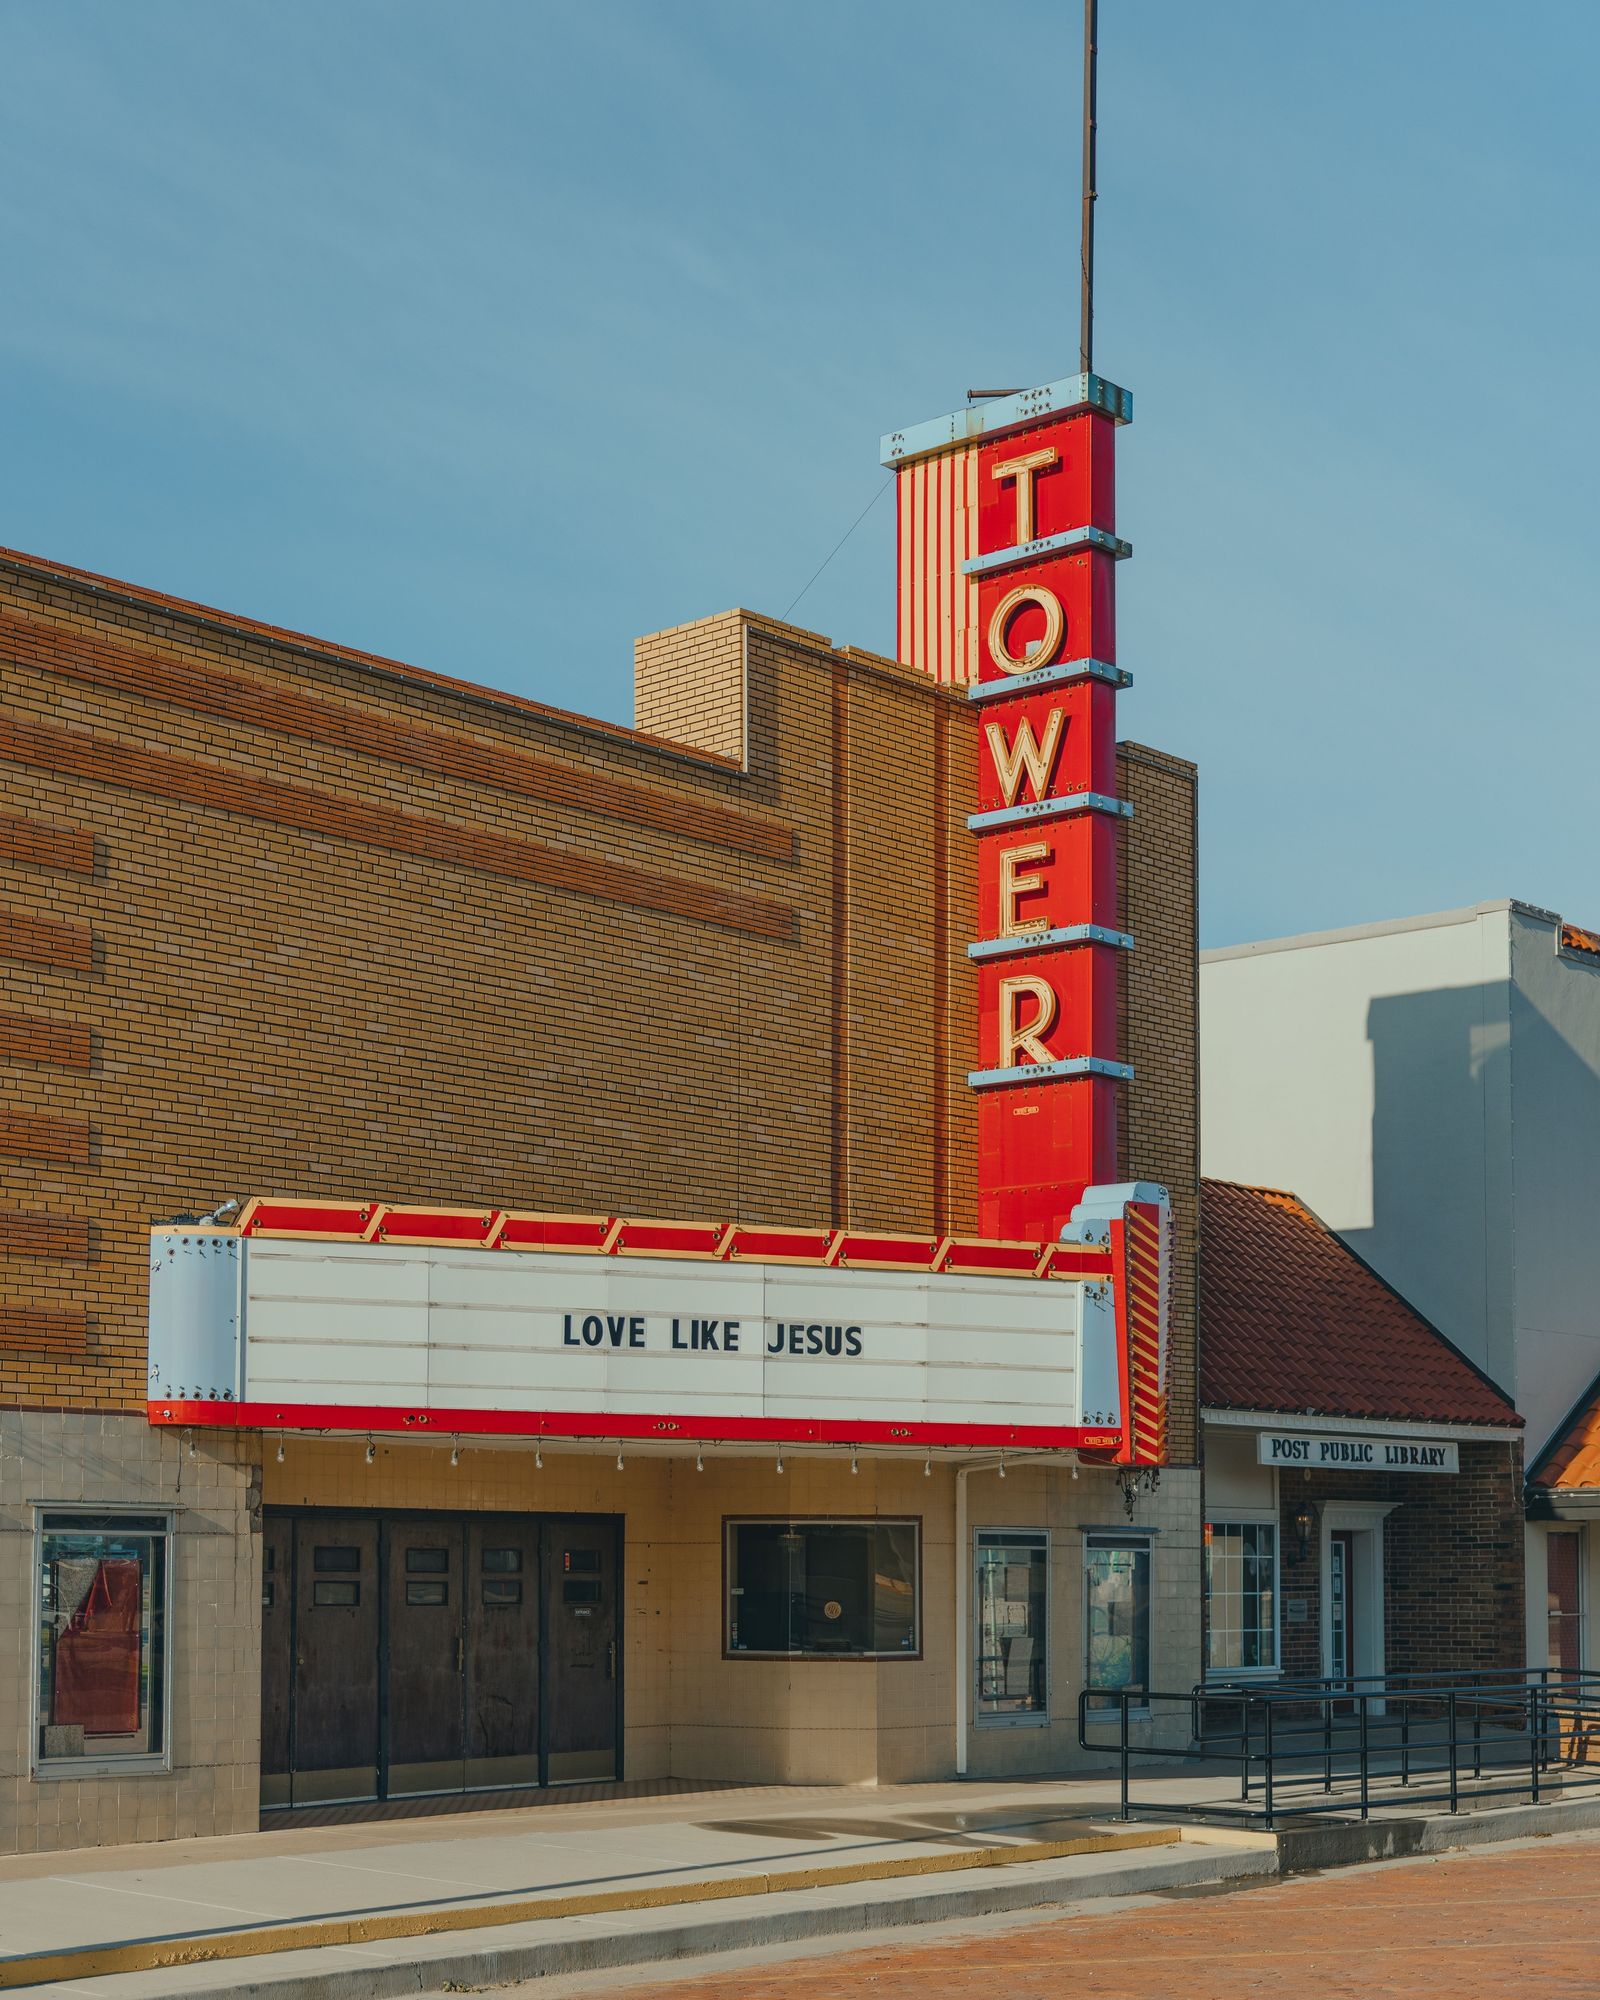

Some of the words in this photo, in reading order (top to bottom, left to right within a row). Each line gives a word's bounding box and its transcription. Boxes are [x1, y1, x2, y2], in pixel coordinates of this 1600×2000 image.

[985, 446, 1065, 1070] TOWER
[563, 1314, 646, 1348] LOVE
[672, 1319, 740, 1351] LIKE
[768, 1323, 862, 1357] JESUS
[1272, 1438, 1310, 1459] POST
[1320, 1442, 1373, 1463] PUBLIC
[1385, 1446, 1446, 1466] LIBRARY
